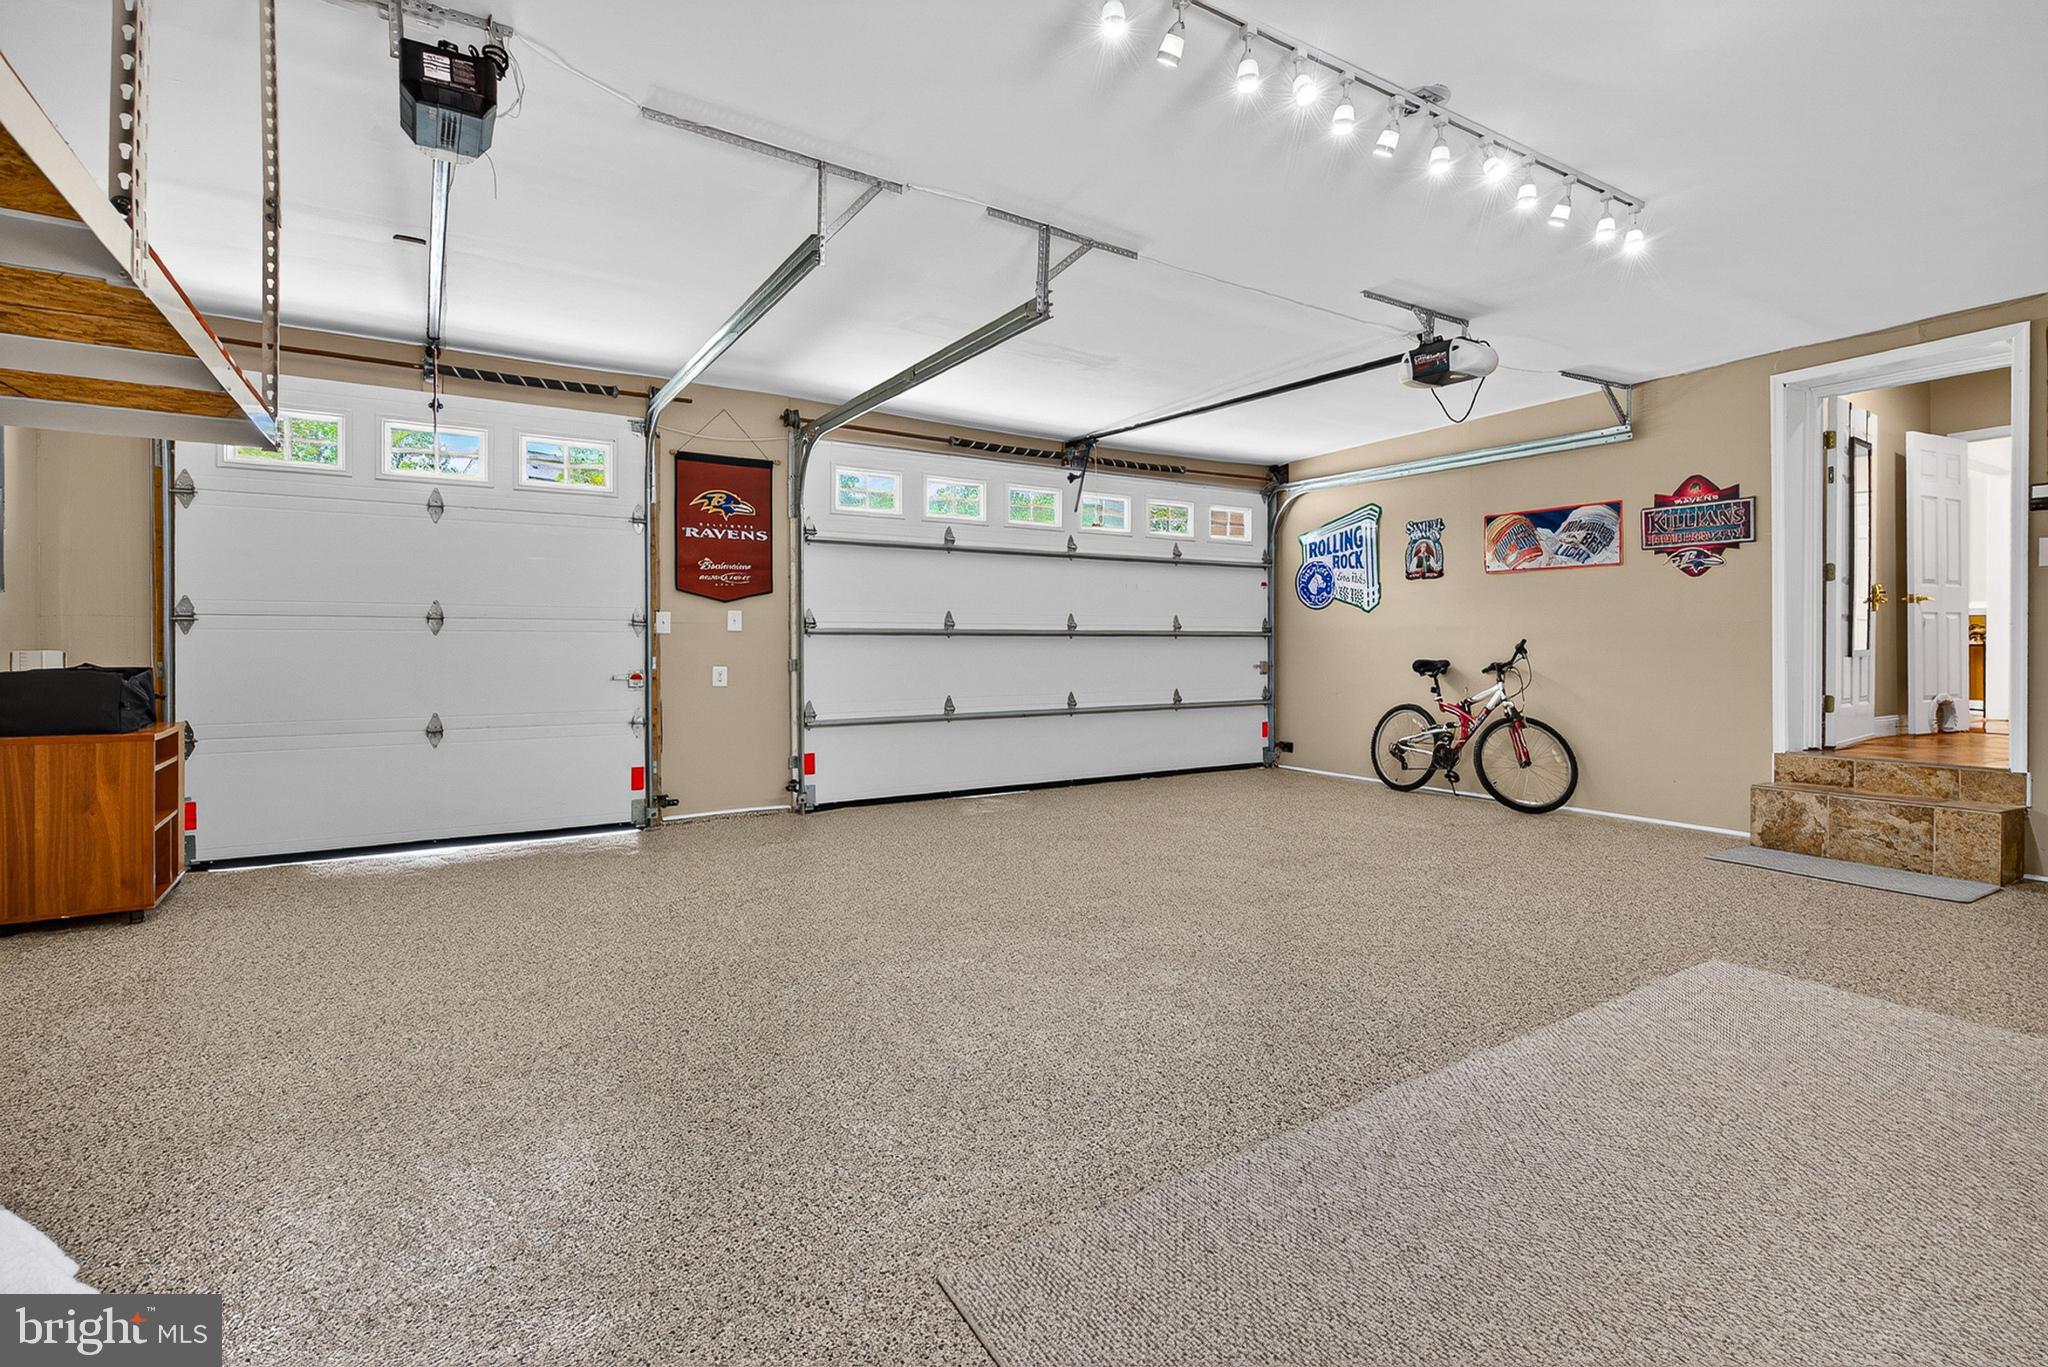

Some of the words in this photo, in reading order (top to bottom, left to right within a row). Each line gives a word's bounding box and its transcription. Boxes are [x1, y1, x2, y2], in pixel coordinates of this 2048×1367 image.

[682, 526, 768, 541] RAVENS
[1309, 525, 1364, 558] ROLLING
[1332, 550, 1364, 569] ROCK
